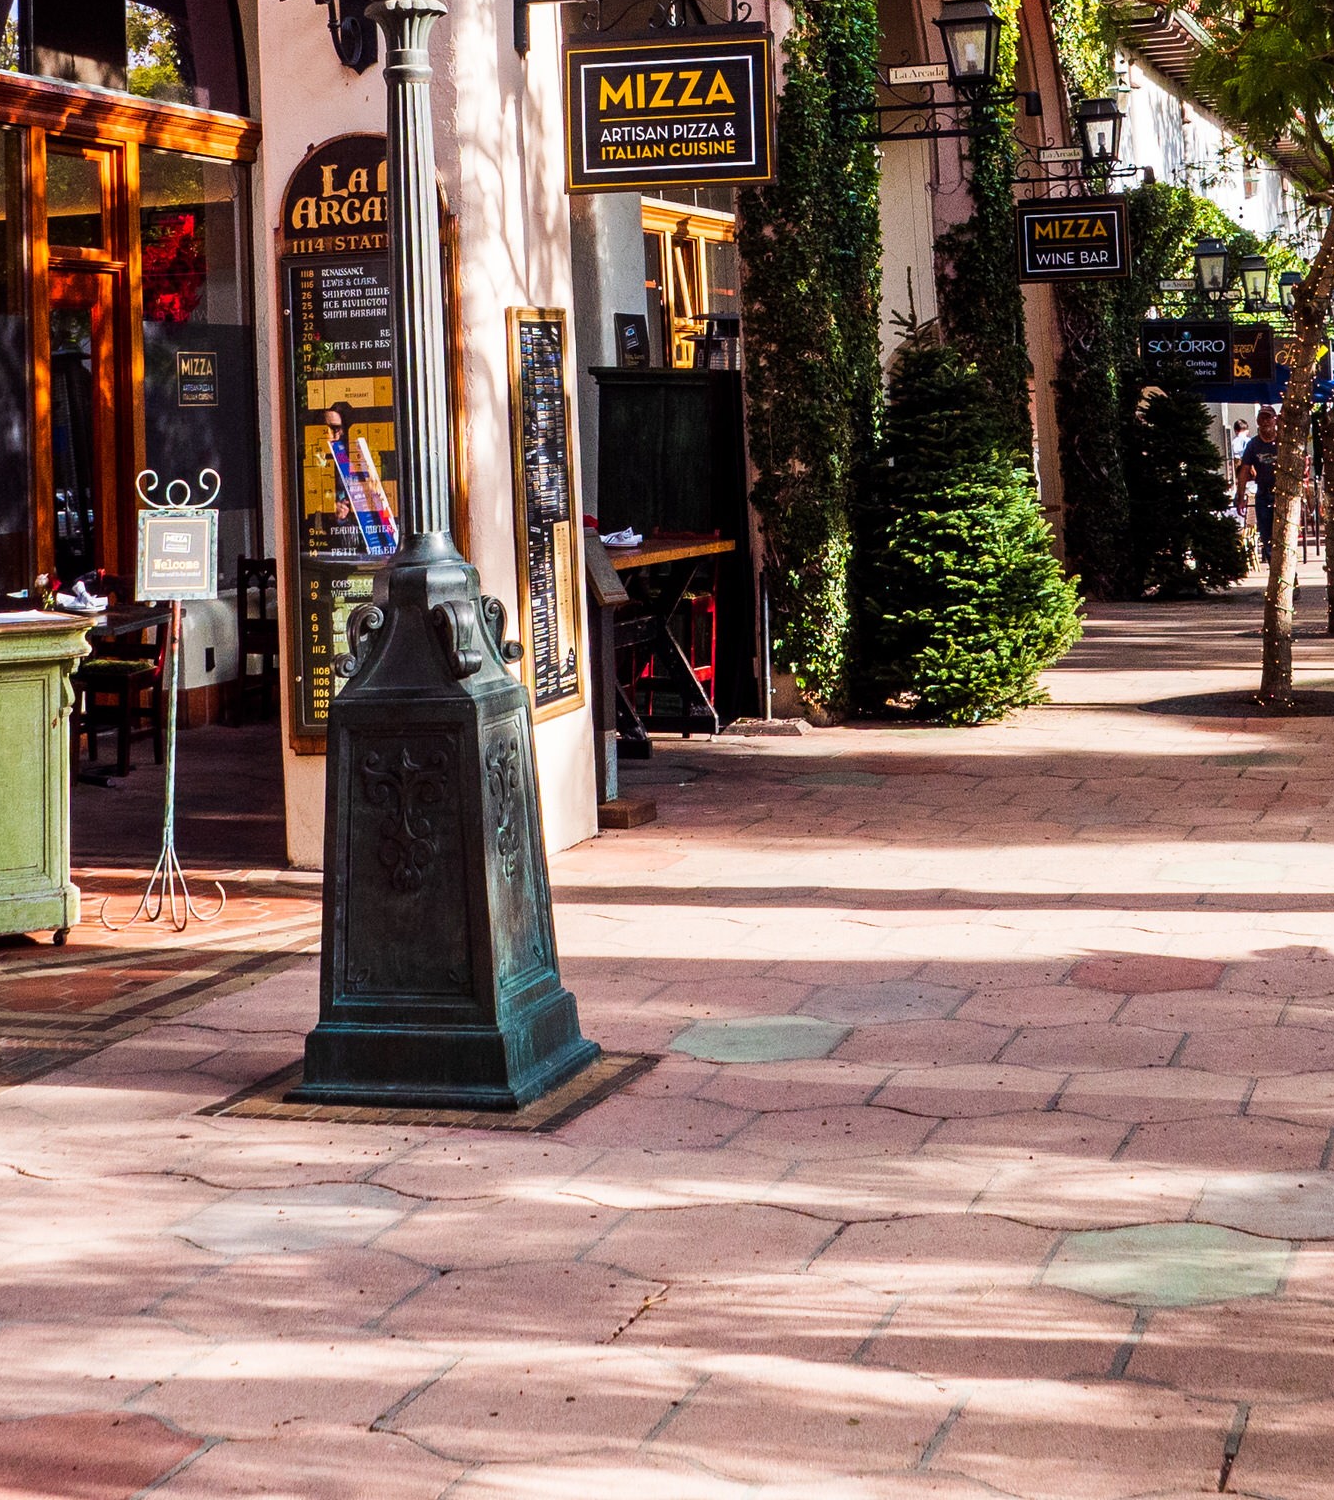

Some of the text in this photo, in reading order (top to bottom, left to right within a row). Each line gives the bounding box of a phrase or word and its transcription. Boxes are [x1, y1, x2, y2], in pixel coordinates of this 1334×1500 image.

[893, 67, 946, 80] La Arcada
[599, 69, 736, 111] MIZZA
[600, 121, 736, 143] ARTISAN PIZZA &
[601, 139, 736, 161] ITALIAN CUISINE
[1054, 149, 1081, 158] Arcada
[292, 196, 388, 230] ARCA
[1034, 219, 1108, 241] MIZZA
[292, 233, 389, 254] 1114 STAT
[1036, 250, 1109, 266] WINE BAR
[321, 266, 364, 277] RENAISSANCE
[322, 279, 344, 288] LEWIS
[353, 276, 378, 285] CLARK
[322, 289, 362, 299] SANFORD
[302, 298, 387, 310] 25 ACE RIVINGTON
[323, 310, 347, 320] SANTA
[350, 308, 387, 318] BARBARA
[324, 341, 350, 350] STATE
[359, 340, 373, 349] FIG
[181, 358, 214, 376] MIZZA
[1186, 360, 1217, 368] Clothing
[153, 558, 200, 570] Welcome
[310, 581, 319, 589] 10
[310, 592, 318, 600] 9
[312, 624, 319, 632] 8
[312, 635, 318, 643] 7
[312, 646, 326, 654] 1112
[313, 667, 330, 675] 1108
[313, 700, 329, 708] 1102
